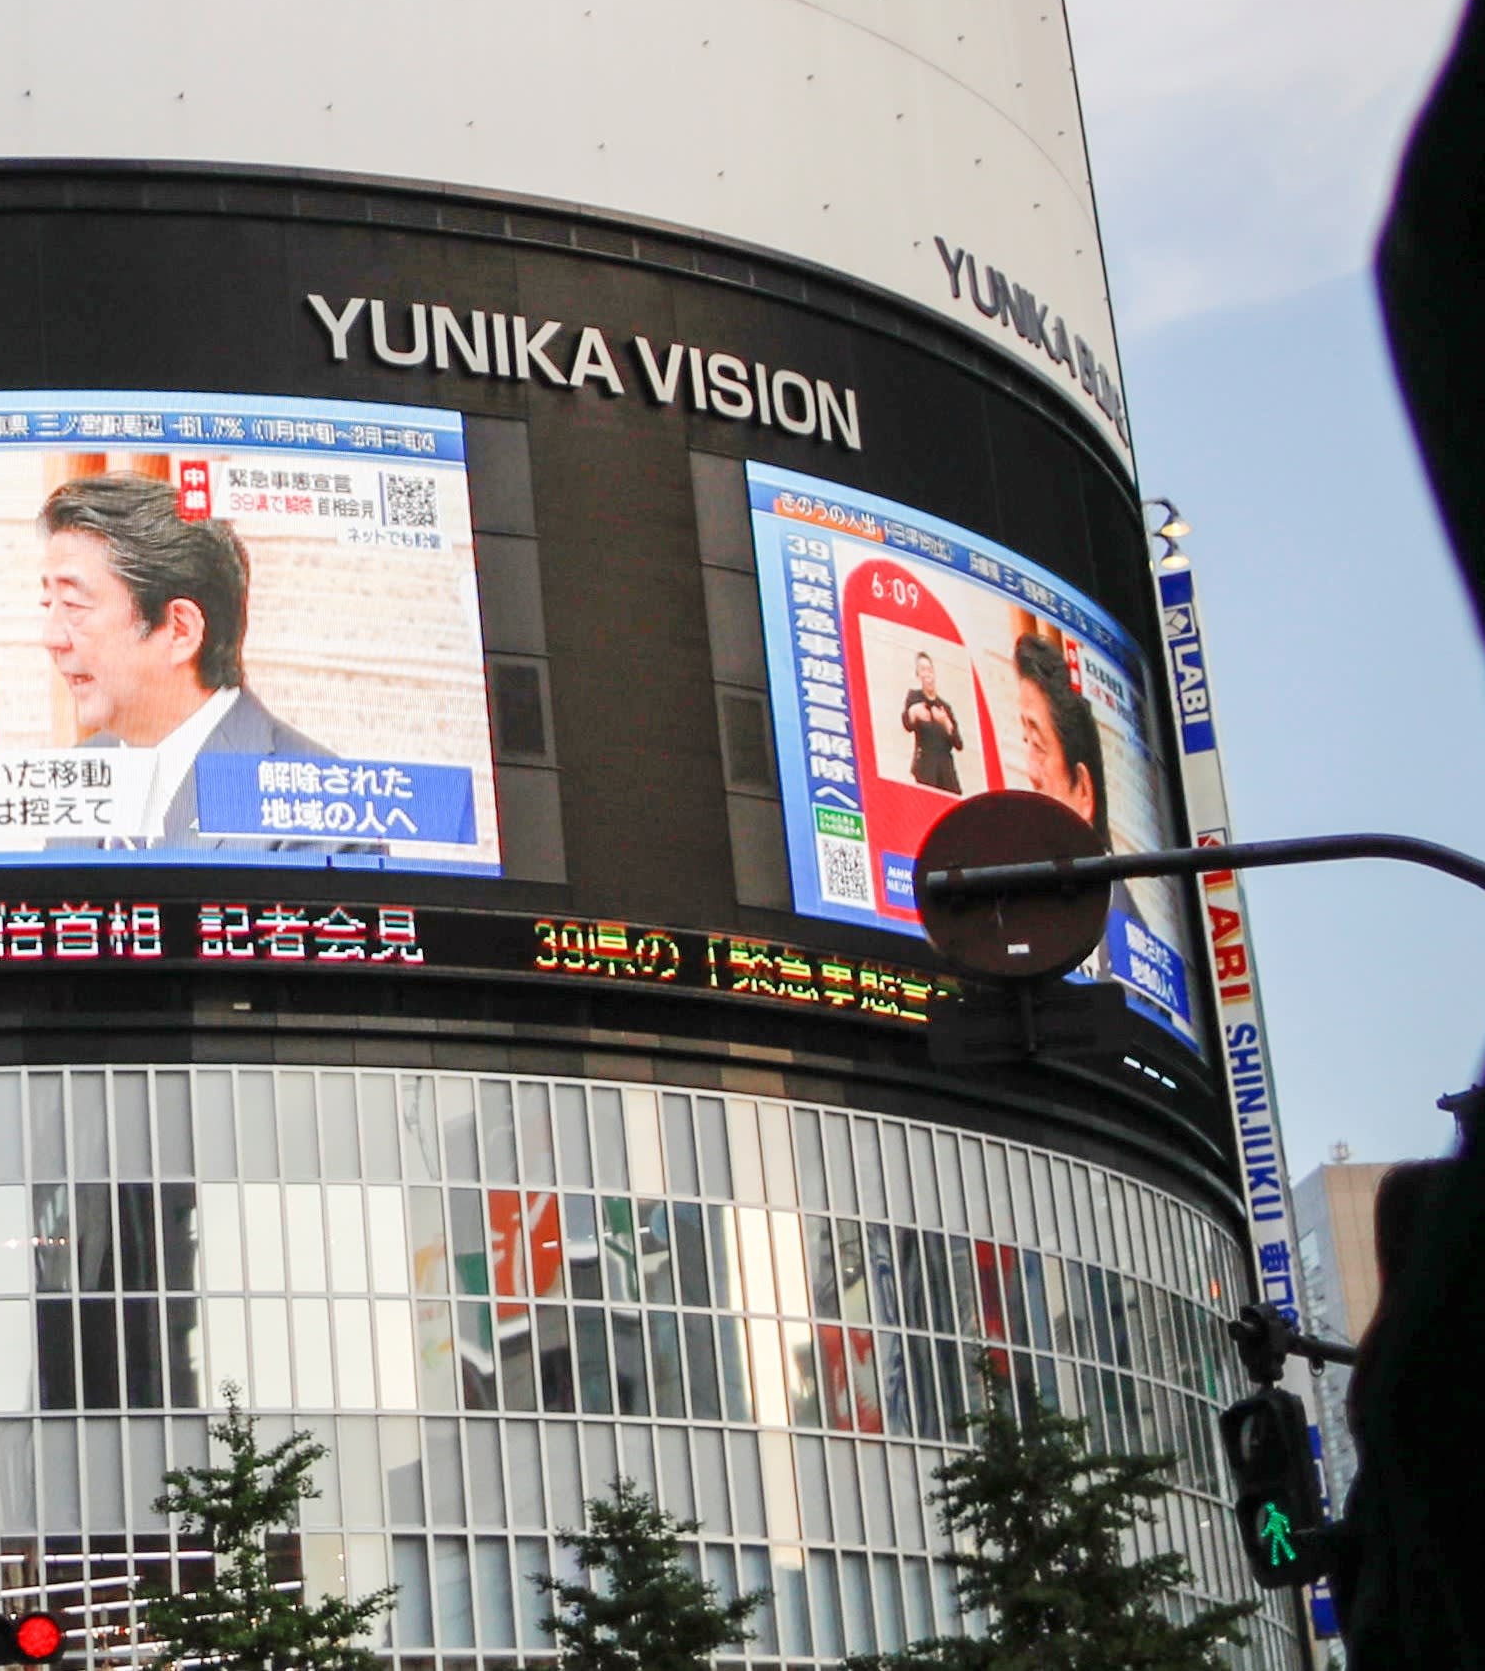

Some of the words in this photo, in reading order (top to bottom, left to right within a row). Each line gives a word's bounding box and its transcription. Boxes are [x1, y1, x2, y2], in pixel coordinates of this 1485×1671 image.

[933, 235, 1078, 379] YUNIKA
[307, 293, 626, 398] YUNIKA
[634, 335, 864, 452] VISION
[228, 468, 352, 496] 緊急事態宣言
[778, 490, 877, 535] きのうの人出
[869, 570, 920, 609] 6:09
[1173, 642, 1210, 725] LABI
[257, 760, 414, 799] 解除された
[260, 798, 419, 835] 地域の人へ
[197, 903, 425, 964] 記者会見
[1225, 1022, 1284, 1223] SHINJUKU
